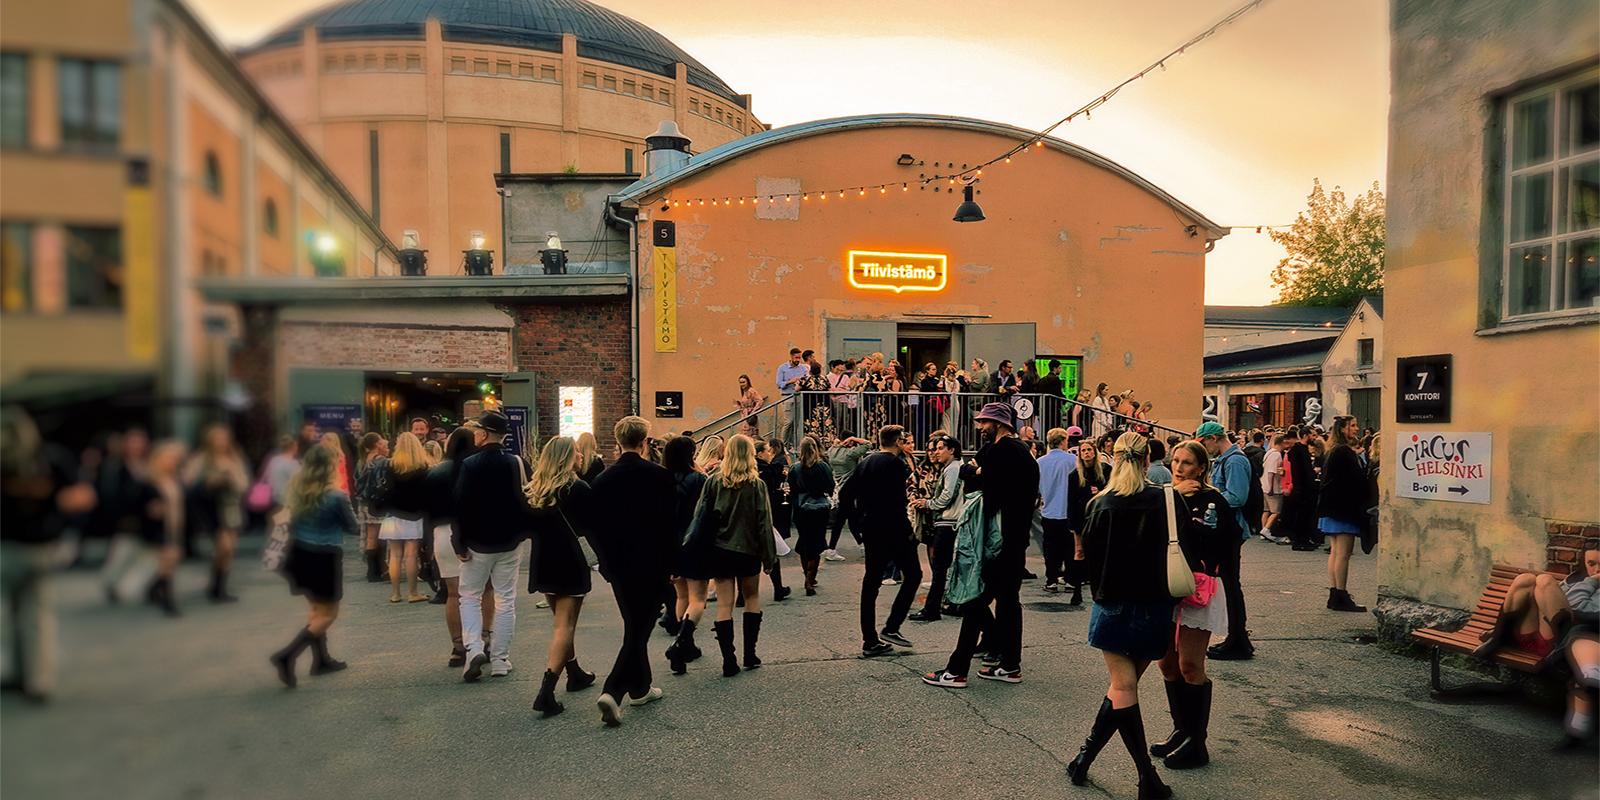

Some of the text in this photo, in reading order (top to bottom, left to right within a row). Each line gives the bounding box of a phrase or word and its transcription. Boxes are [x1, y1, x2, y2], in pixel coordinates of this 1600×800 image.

[661, 229, 668, 238] 5
[860, 263, 935, 279] Tiivistämö
[1417, 372, 1428, 390] 7
[1402, 435, 1470, 471] CIRCUS
[1416, 461, 1484, 479] HELSINKI
[1413, 483, 1437, 493] B-ovi
